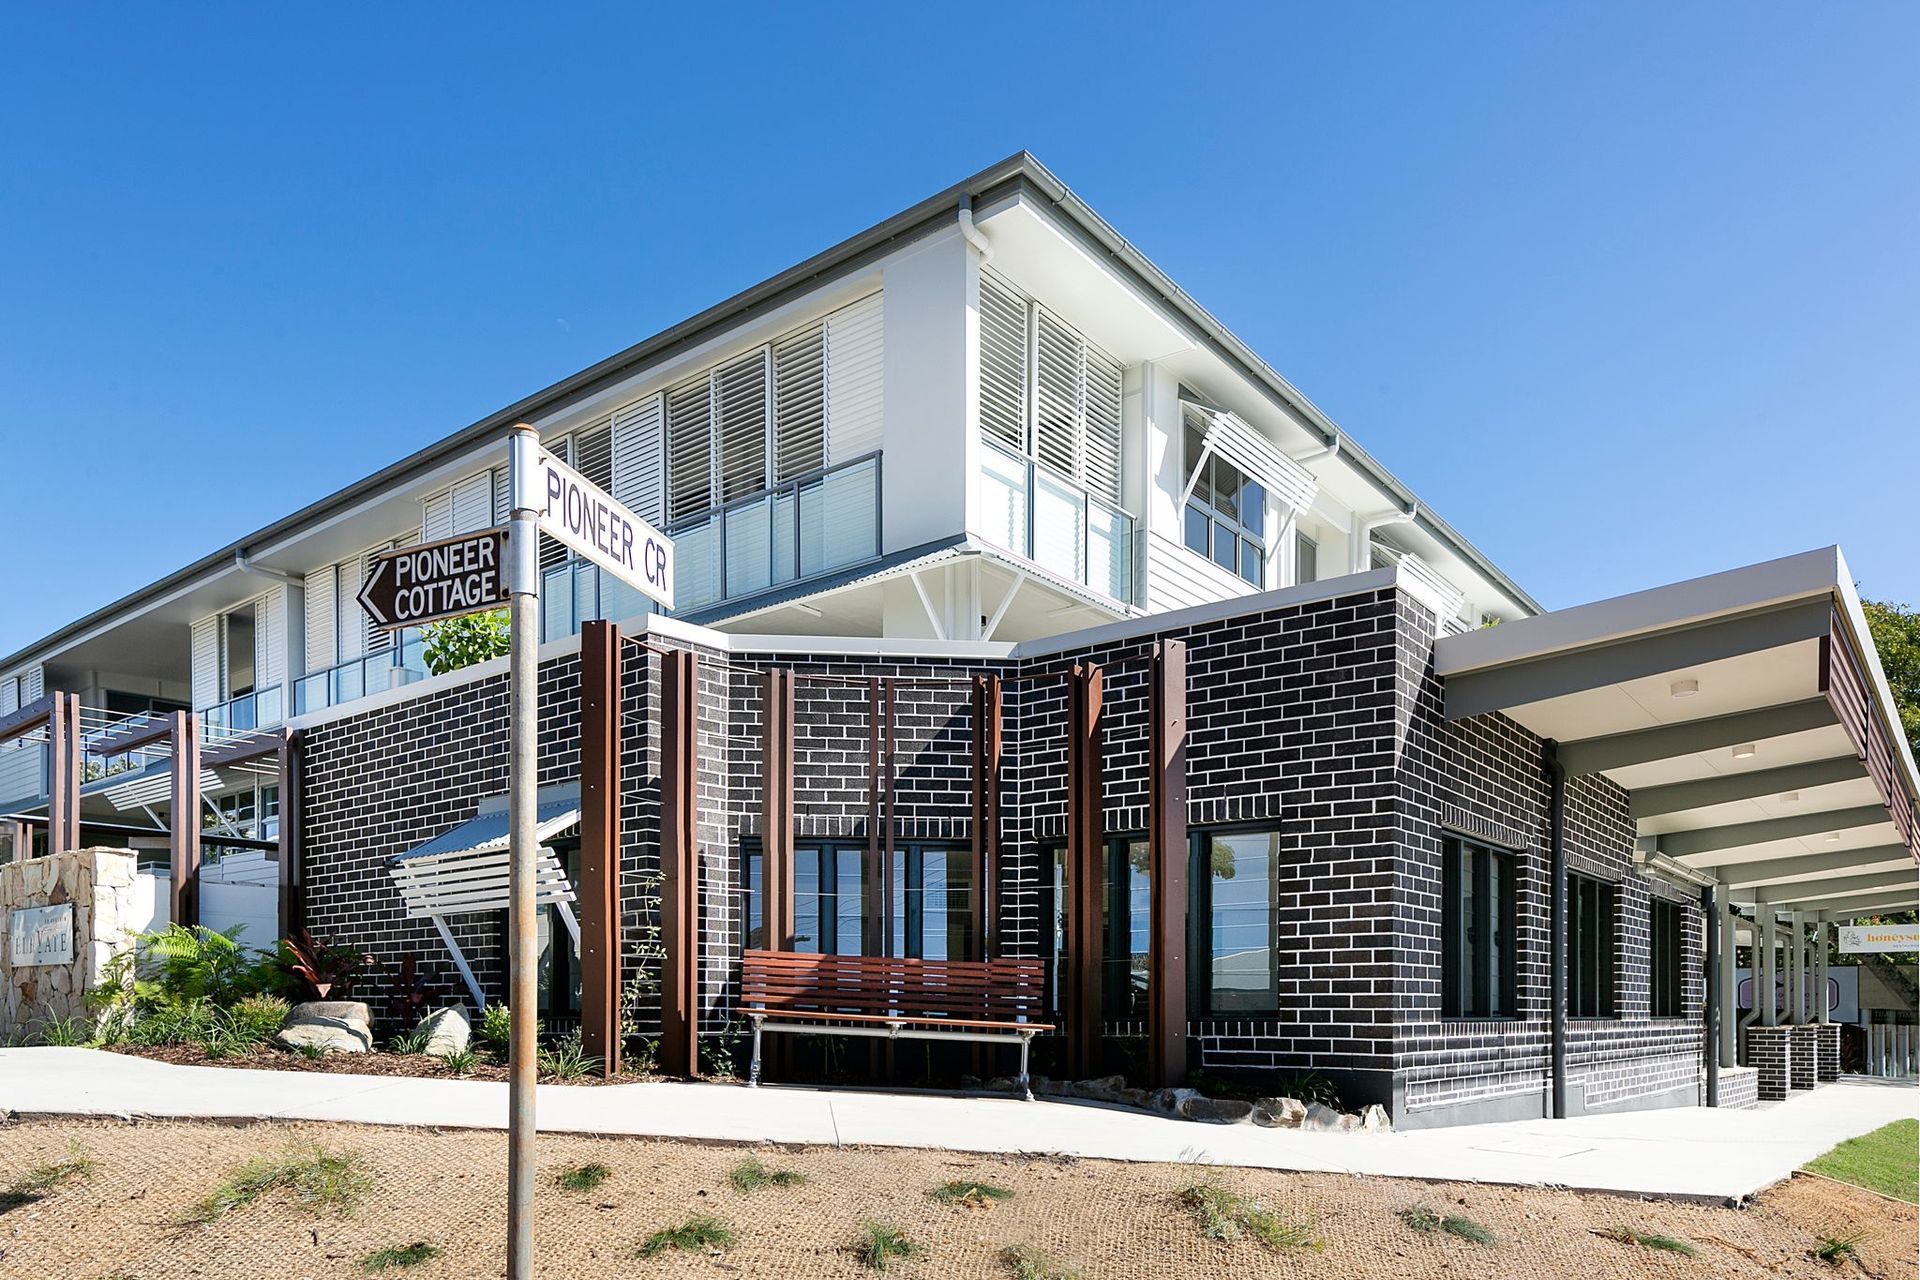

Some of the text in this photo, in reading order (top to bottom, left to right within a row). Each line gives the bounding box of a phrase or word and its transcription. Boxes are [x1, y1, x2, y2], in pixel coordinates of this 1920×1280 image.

[547, 467, 667, 592] PIONEER CR
[395, 536, 495, 587] PIONEER
[394, 570, 496, 620] COTTAGE
